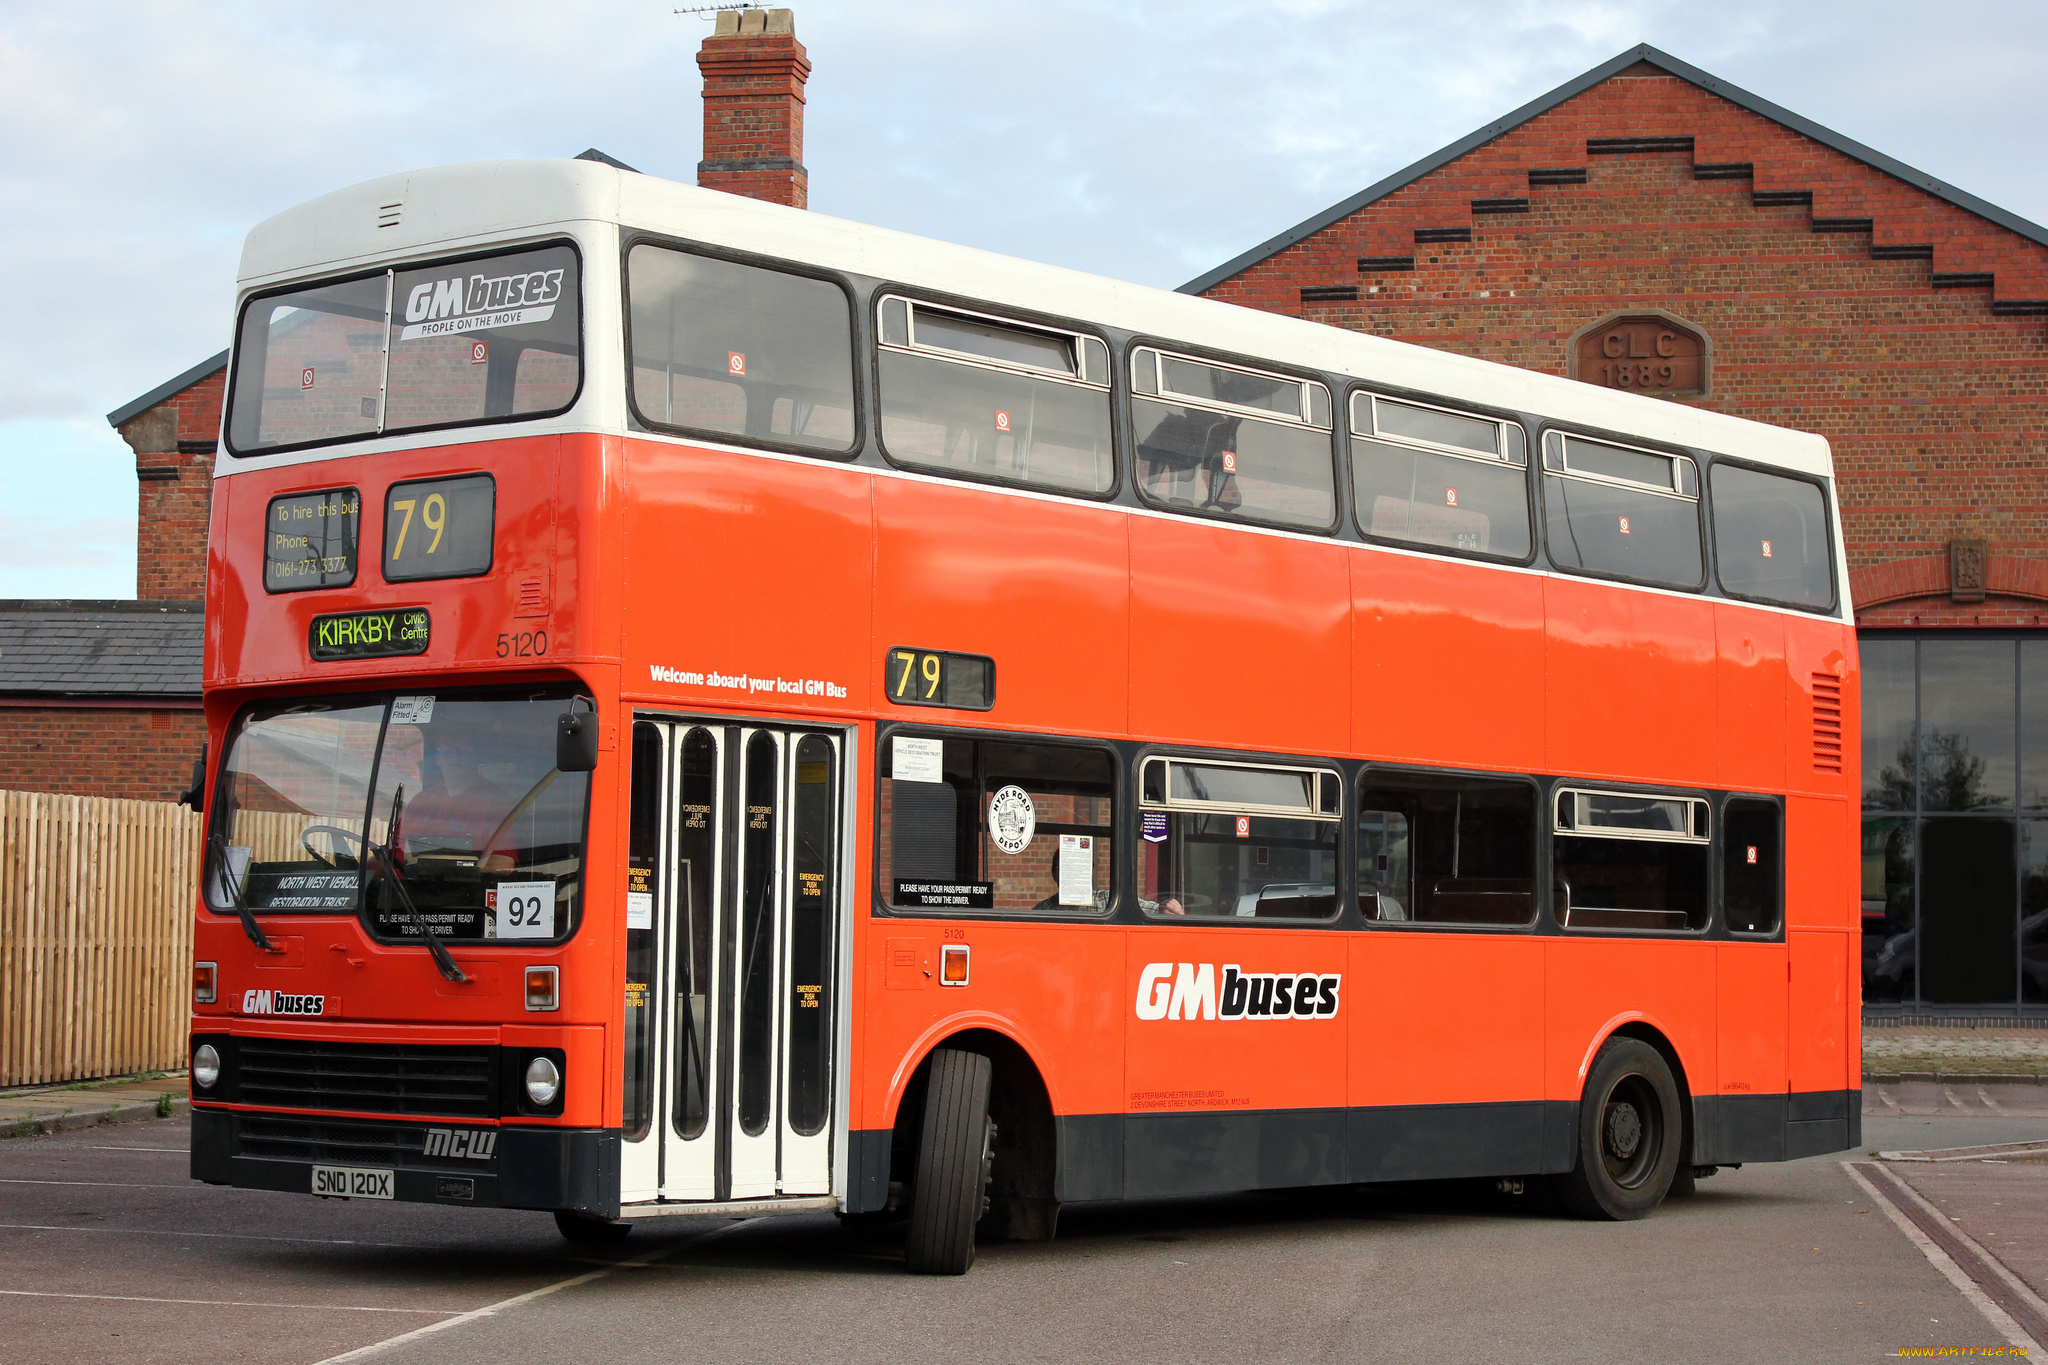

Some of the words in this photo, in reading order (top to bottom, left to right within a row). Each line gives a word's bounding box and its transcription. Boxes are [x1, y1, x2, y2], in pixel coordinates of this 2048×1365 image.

[421, 321, 454, 335] PEOPLE
[457, 318, 473, 330] ON
[475, 316, 491, 327] THE
[494, 312, 522, 324] MOVE
[1603, 362, 1675, 388] 1889
[277, 506, 289, 521] To
[293, 505, 313, 520] hire
[317, 501, 337, 517] this
[341, 499, 359, 515] bus
[392, 493, 446, 560] 79
[276, 534, 308, 549] Phone
[275, 559, 317, 577] 0161-273
[321, 556, 347, 573] 3377
[403, 613, 427, 625] Civic
[319, 614, 396, 647] KIRKBY
[401, 627, 428, 640] Centre
[496, 630, 548, 658] 5120
[650, 664, 704, 685] Welcome
[706, 671, 747, 689] aboard
[748, 677, 776, 694] your
[777, 677, 803, 694] local
[805, 679, 825, 696] GM
[826, 681, 847, 698] Bus
[896, 651, 940, 699] 79
[395, 701, 413, 709] Alarm
[392, 711, 410, 719] Fitted
[993, 790, 1010, 812] HYDE
[1012, 790, 1031, 812] ROAD
[998, 836, 1024, 850] DEPOT
[277, 877, 307, 890] NORTH
[305, 876, 330, 889] WEST
[633, 876, 645, 884] PUSH
[799, 872, 825, 882] EMERGENCY
[630, 883, 637, 891] TO
[636, 884, 648, 892] OPEN
[806, 881, 818, 889] PUSH
[900, 883, 918, 893] PLEASE
[918, 884, 930, 893] HAVE
[930, 885, 943, 893] YOUR
[943, 885, 972, 894] PASS/PERMIT
[972, 886, 988, 895] READY
[802, 887, 809, 896] TO
[809, 888, 821, 896] OPEN
[269, 896, 323, 908] RESTORATION
[322, 896, 350, 907] TRUST
[921, 895, 928, 904] TO
[928, 895, 942, 904] SHOW
[943, 896, 952, 904] THE
[508, 896, 542, 927] 92
[457, 914, 475, 923] READY
[401, 925, 409, 934] TO
[944, 929, 965, 939] 5120
[796, 984, 822, 993] EMERGENCY
[804, 992, 815, 1000] PUSH
[632, 998, 644, 1007] OPEN
[800, 1000, 807, 1008] TO
[806, 1000, 819, 1008] OPEN
[1130, 1092, 1154, 1100] GREATER
[1154, 1091, 1188, 1099] MANCHESTER
[1189, 1090, 1205, 1098] BUSES
[1206, 1090, 1225, 1098] LIMITED
[1134, 1100, 1167, 1108] DEVONSHIRE
[1168, 1099, 1187, 1108] STREET
[423, 1128, 497, 1160] MCW
[317, 1170, 346, 1193] SND
[351, 1172, 389, 1196] 120X
